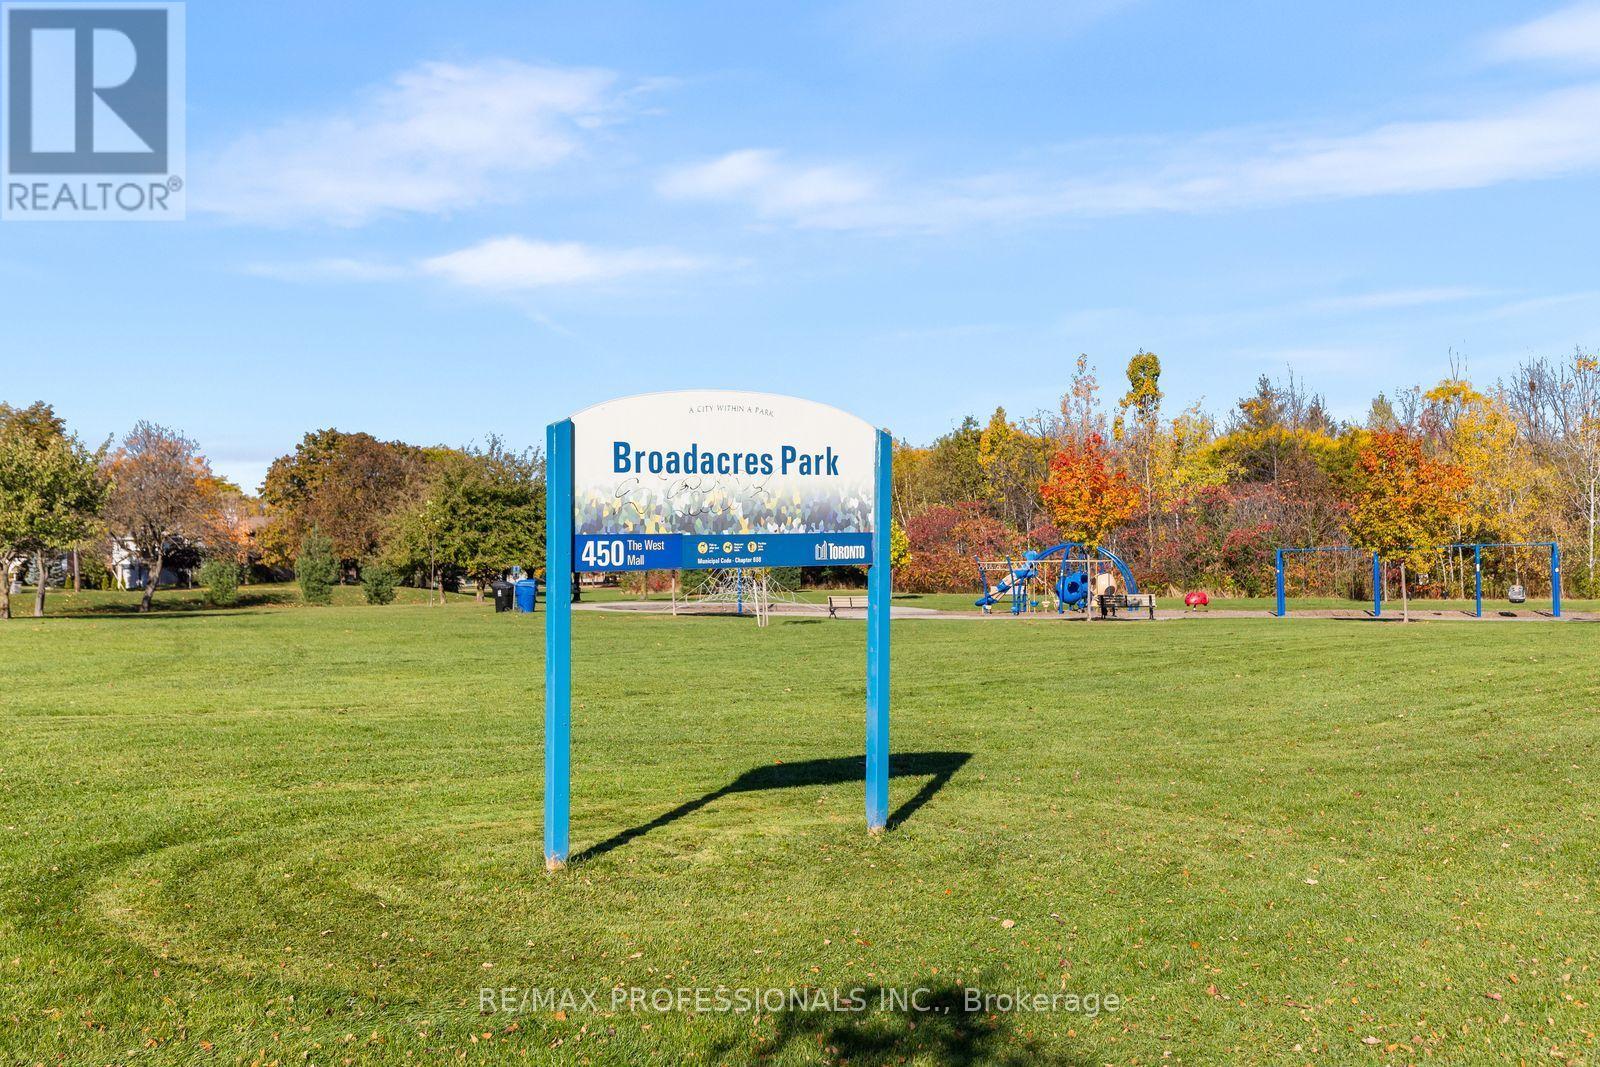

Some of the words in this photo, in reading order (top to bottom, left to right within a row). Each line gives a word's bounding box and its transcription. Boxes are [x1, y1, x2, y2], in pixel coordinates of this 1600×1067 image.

[697, 405, 714, 413] CITY
[717, 404, 744, 413] WITHIN
[755, 406, 775, 418] PARK
[613, 441, 774, 475] Broadacres
[781, 445, 839, 476] Park
[626, 539, 643, 551] The
[644, 539, 665, 551] West
[581, 540, 625, 567] 450
[627, 554, 645, 566] Mall
[697, 557, 720, 565] Municipal
